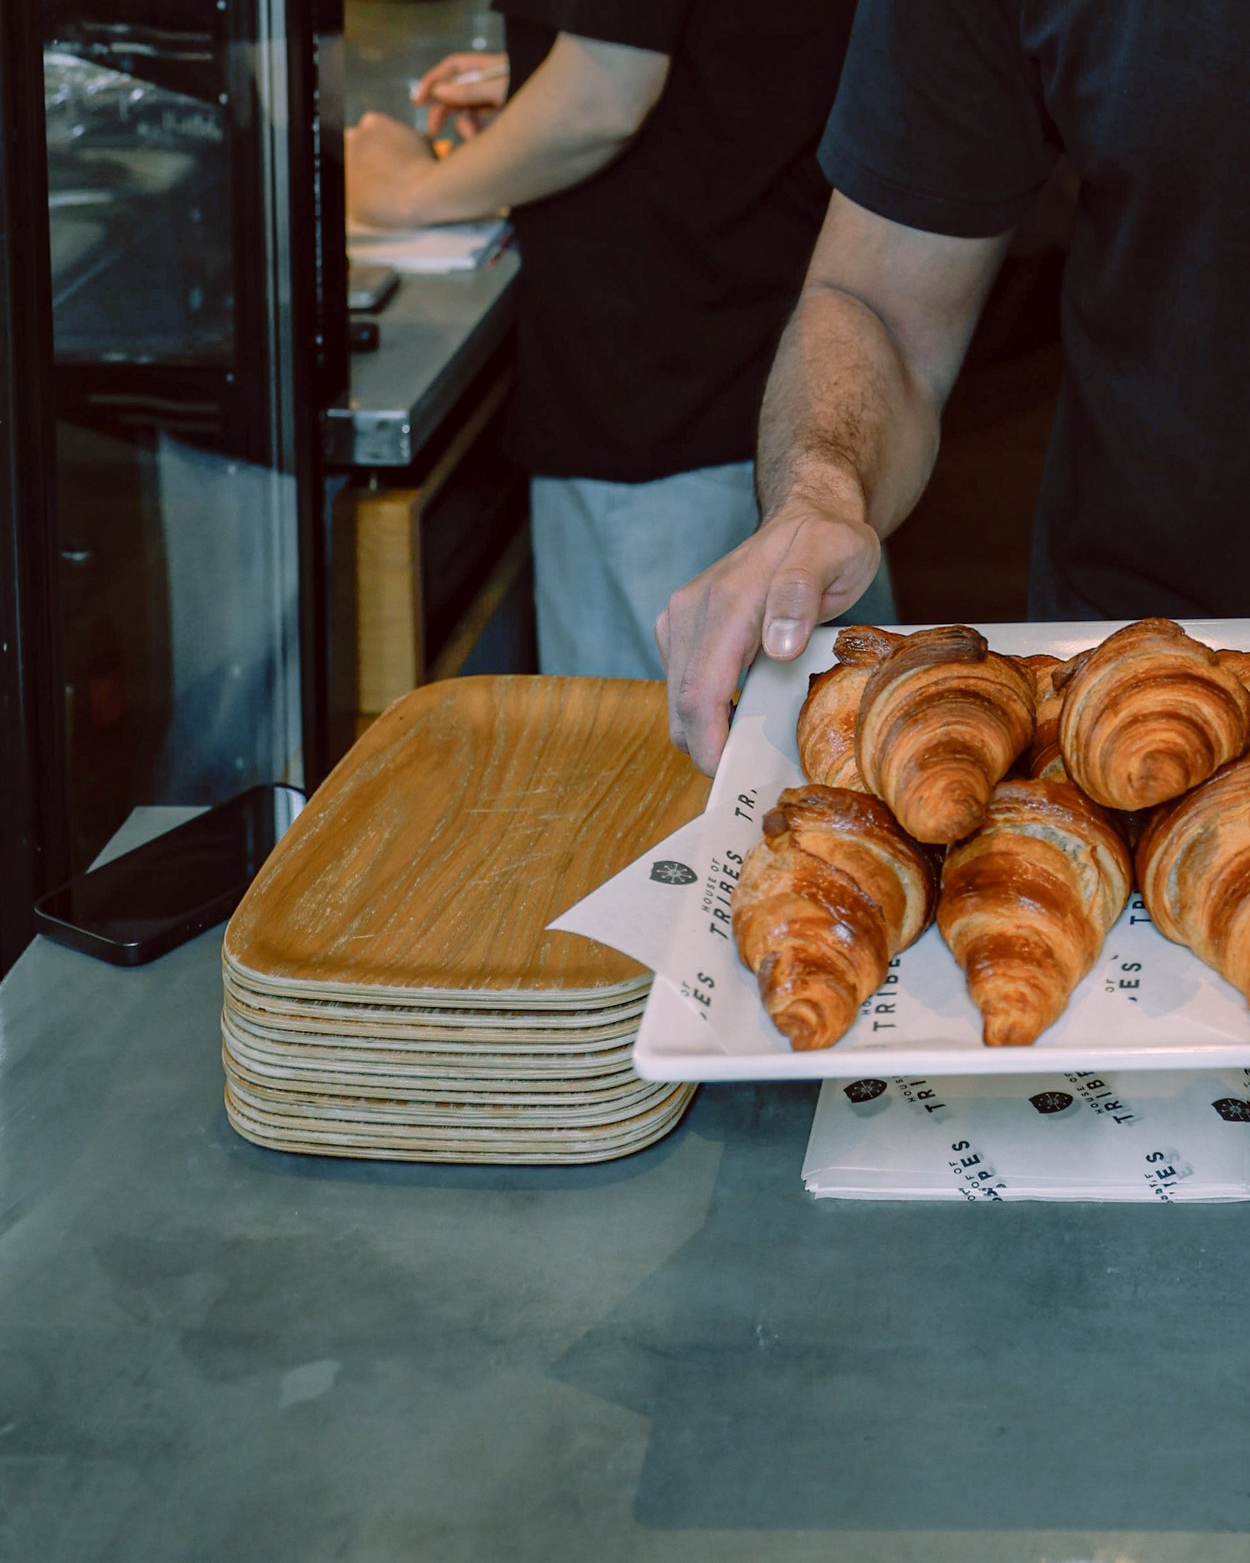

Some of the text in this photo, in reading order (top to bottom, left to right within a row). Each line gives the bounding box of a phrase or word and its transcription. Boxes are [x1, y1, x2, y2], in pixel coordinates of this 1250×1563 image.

[702, 857, 721, 913] HOUSE OF
[709, 849, 743, 941] TRIBES
[693, 972, 716, 1021] ES
[1119, 962, 1142, 1003] ES
[892, 1075, 917, 1103] HOUS
[904, 1075, 947, 1114] TRI
[1076, 1085, 1105, 1115] HOUSE
[948, 1160, 962, 1175] OF
